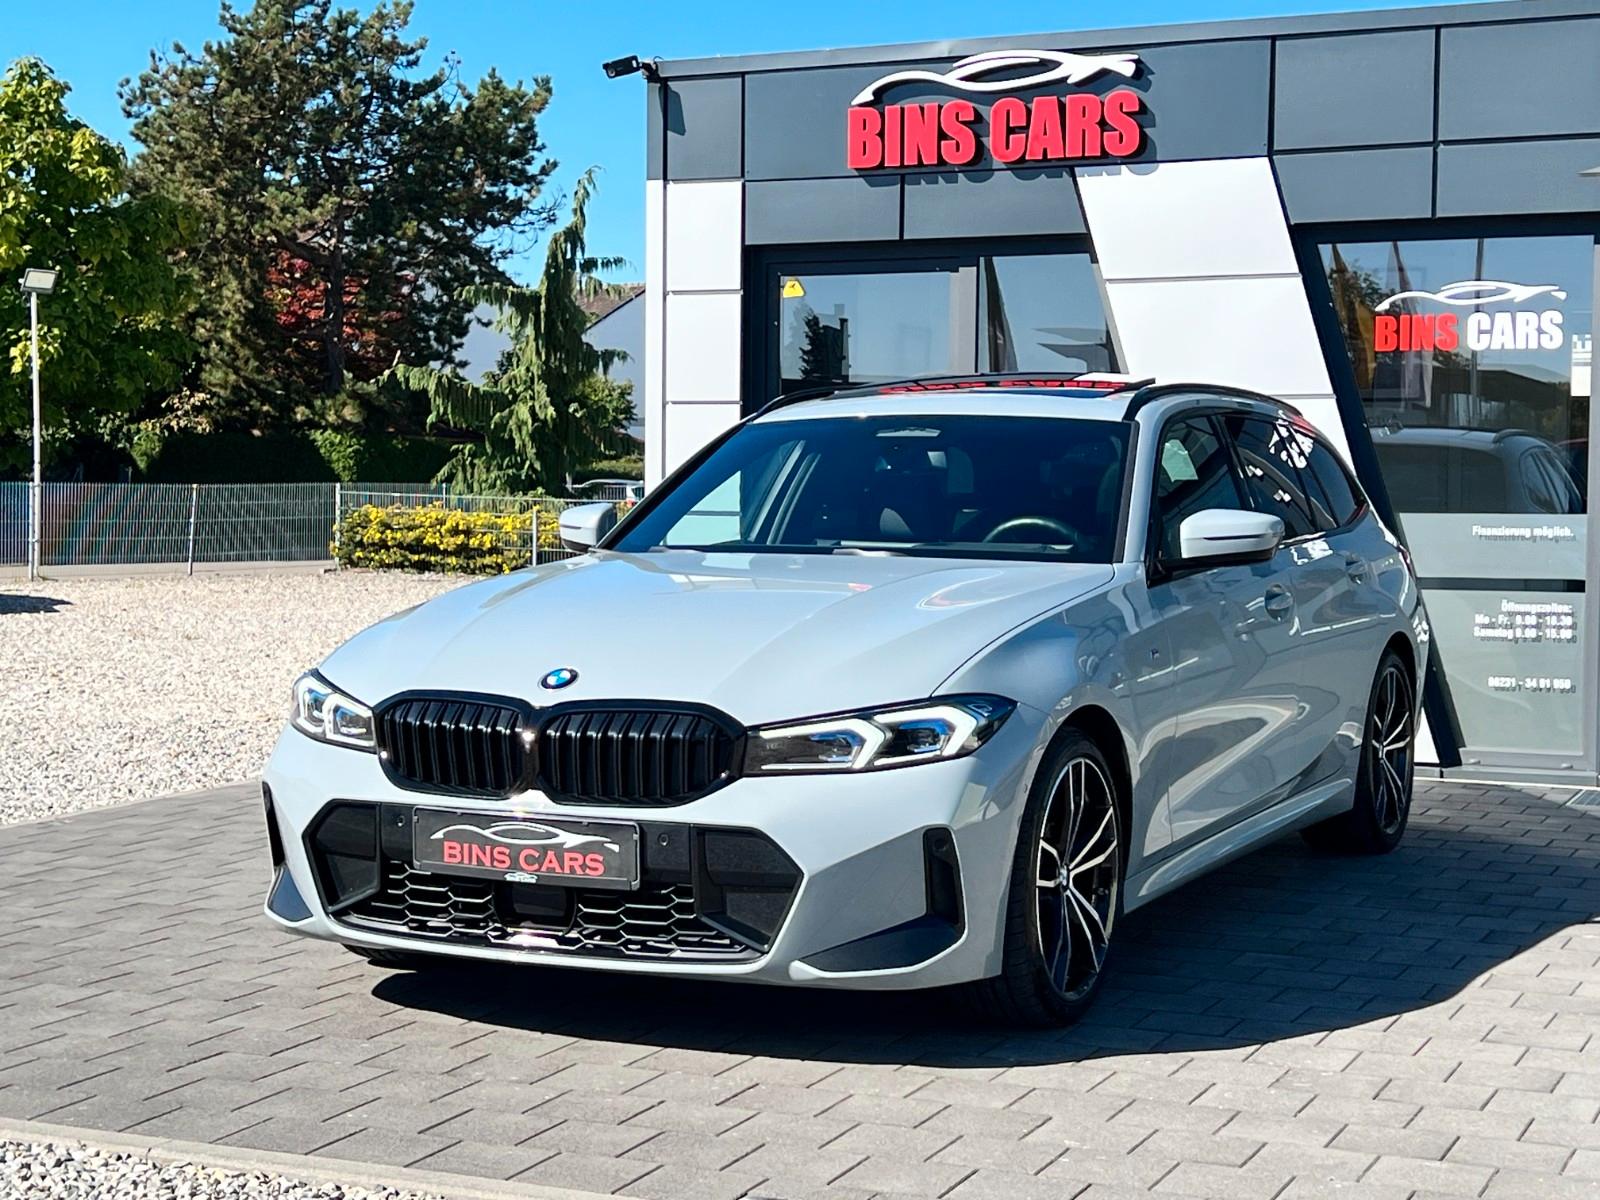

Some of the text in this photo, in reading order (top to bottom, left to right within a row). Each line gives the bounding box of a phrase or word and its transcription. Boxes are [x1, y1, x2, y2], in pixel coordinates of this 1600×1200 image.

[848, 90, 1141, 169] BINS CARS
[1374, 310, 1564, 352] BINS CARS
[1472, 525, 1574, 538] Finanzierung möglich.
[443, 841, 604, 876] BINS CARS
